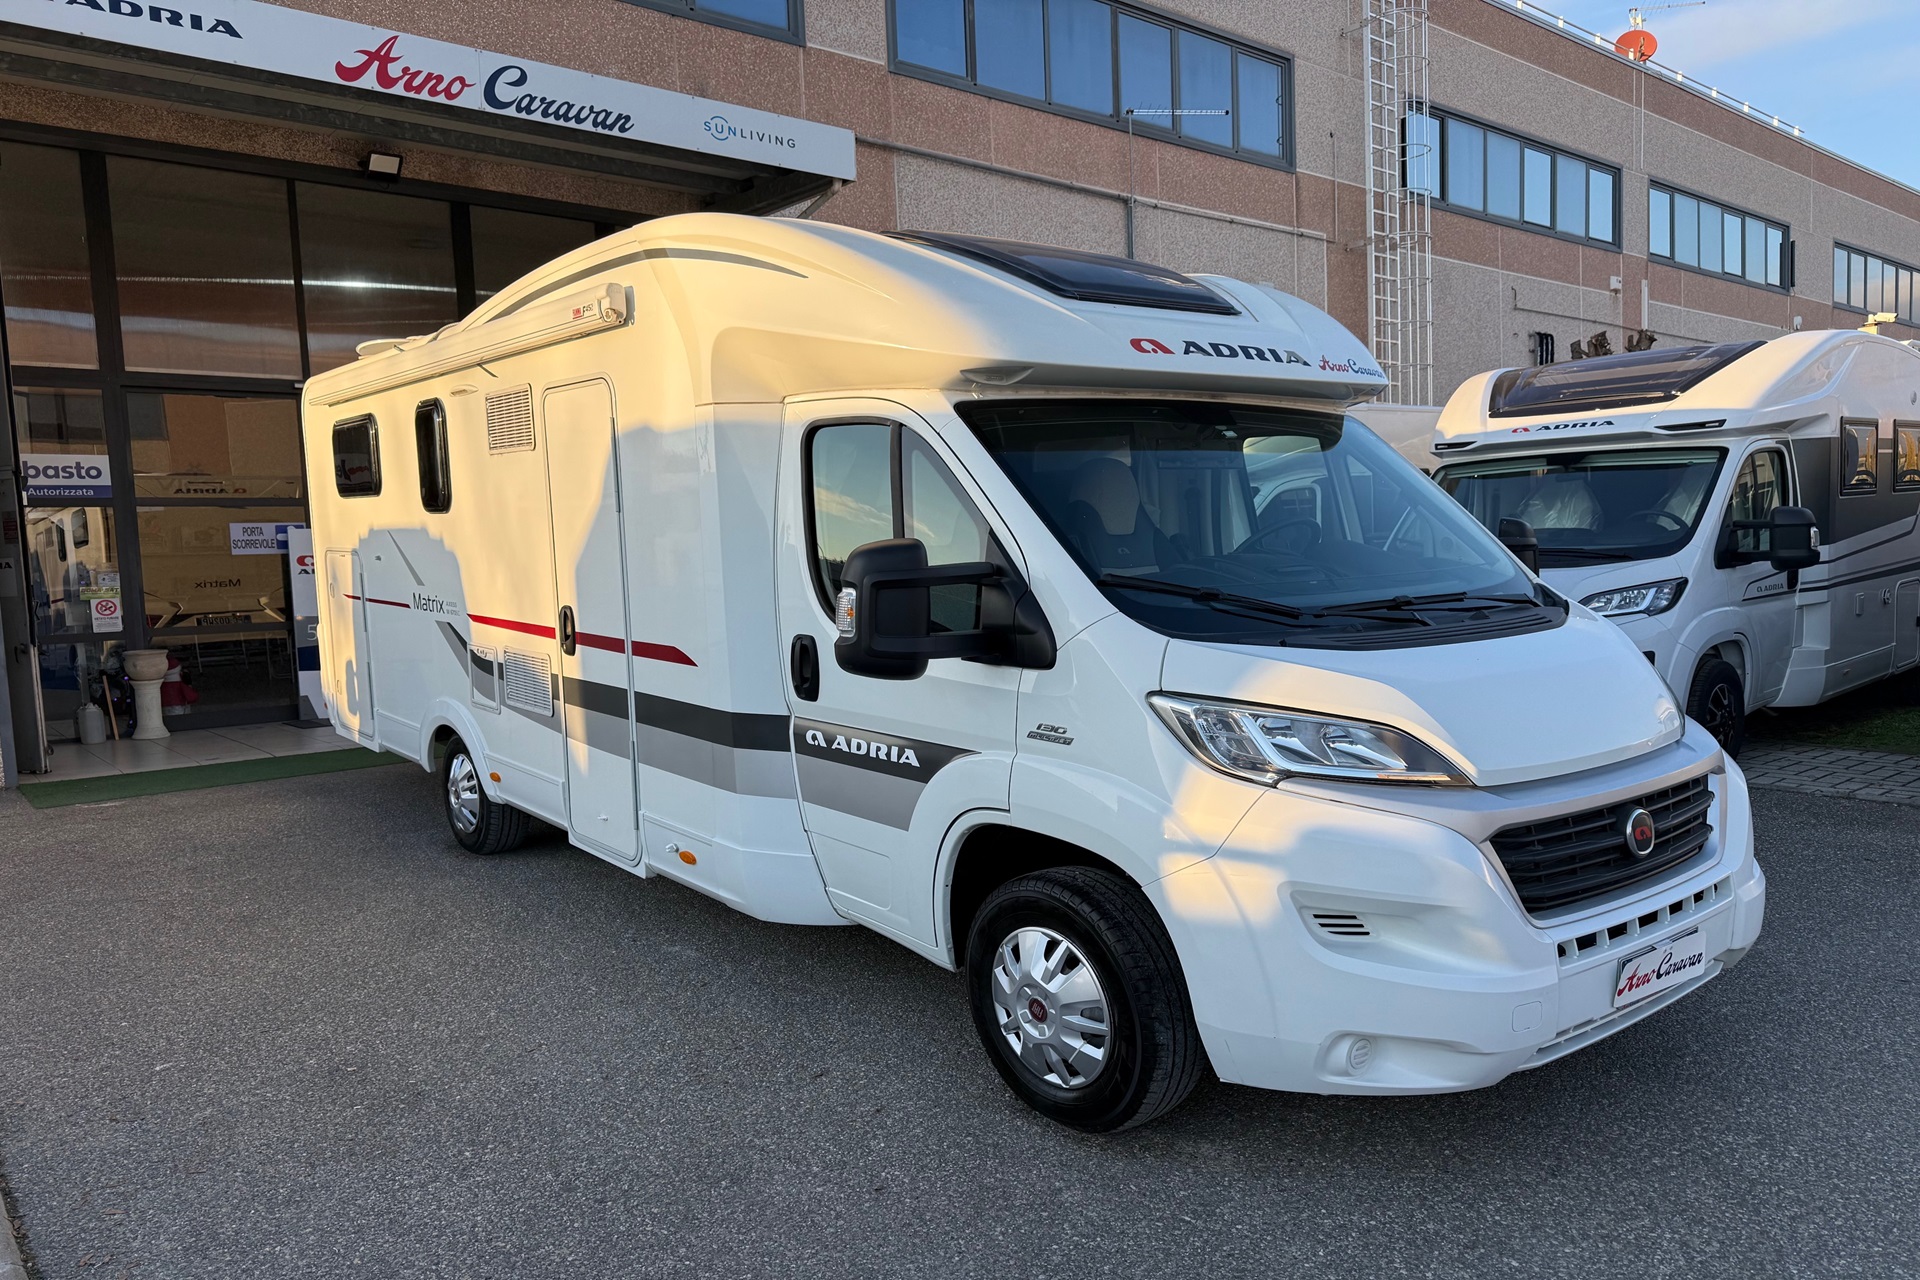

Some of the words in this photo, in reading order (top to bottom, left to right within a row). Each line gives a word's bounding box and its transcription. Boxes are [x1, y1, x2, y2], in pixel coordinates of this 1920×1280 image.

[334, 35, 477, 101] Arno
[483, 65, 635, 134] Caravan
[703, 120, 797, 149] SUNLIVING
[1182, 340, 1312, 367] ADRIA
[1318, 354, 1349, 373] Arno
[1535, 420, 1615, 432] ADRIA
[22, 461, 103, 480] basto
[27, 487, 95, 496] Autorizzata
[242, 526, 264, 537] PORTA
[232, 538, 276, 550] SCORREVOLE
[1763, 583, 1785, 592] ADRIA
[413, 592, 446, 614] Matrix
[1036, 722, 1068, 735] 130
[831, 734, 921, 768] ADRIA
[1616, 962, 1657, 997] Arno
[1656, 951, 1704, 980] Caravan
